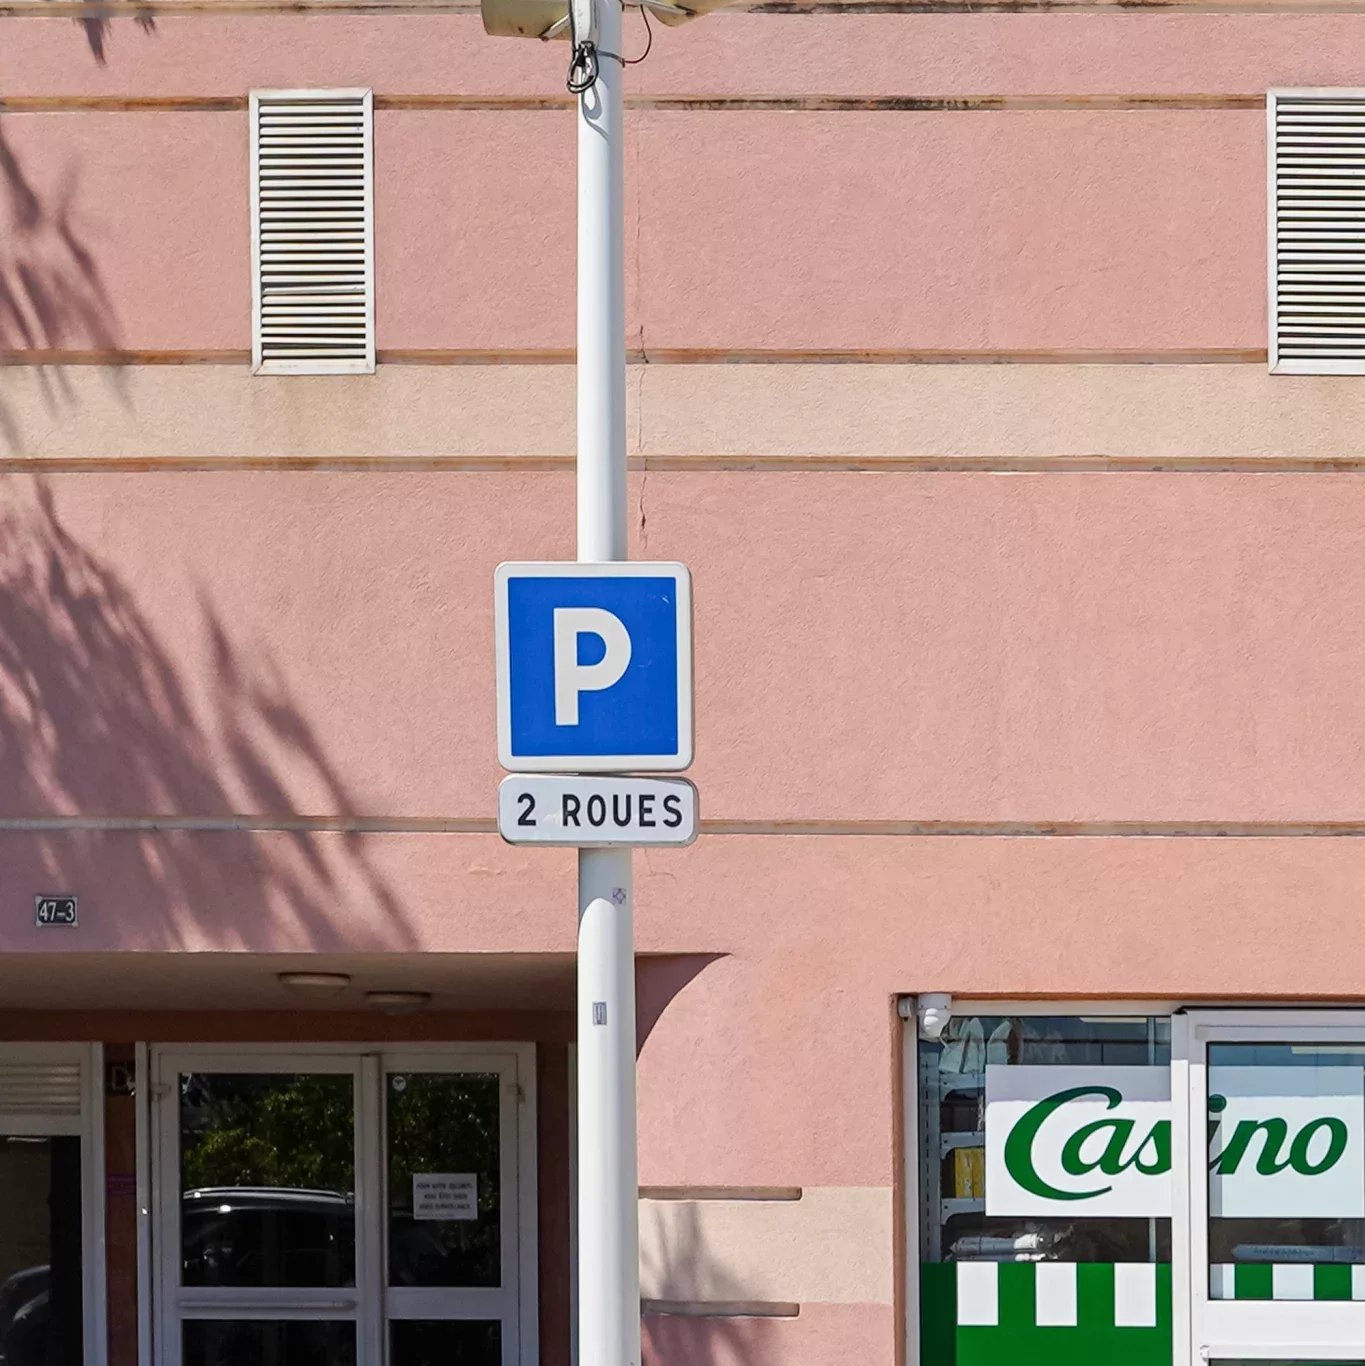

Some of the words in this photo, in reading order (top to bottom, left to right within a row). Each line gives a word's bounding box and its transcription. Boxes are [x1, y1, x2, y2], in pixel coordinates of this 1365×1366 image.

[553, 607, 633, 726] P
[517, 793, 536, 826] 2
[562, 793, 683, 827] ROUES
[39, 901, 75, 922] 47-3
